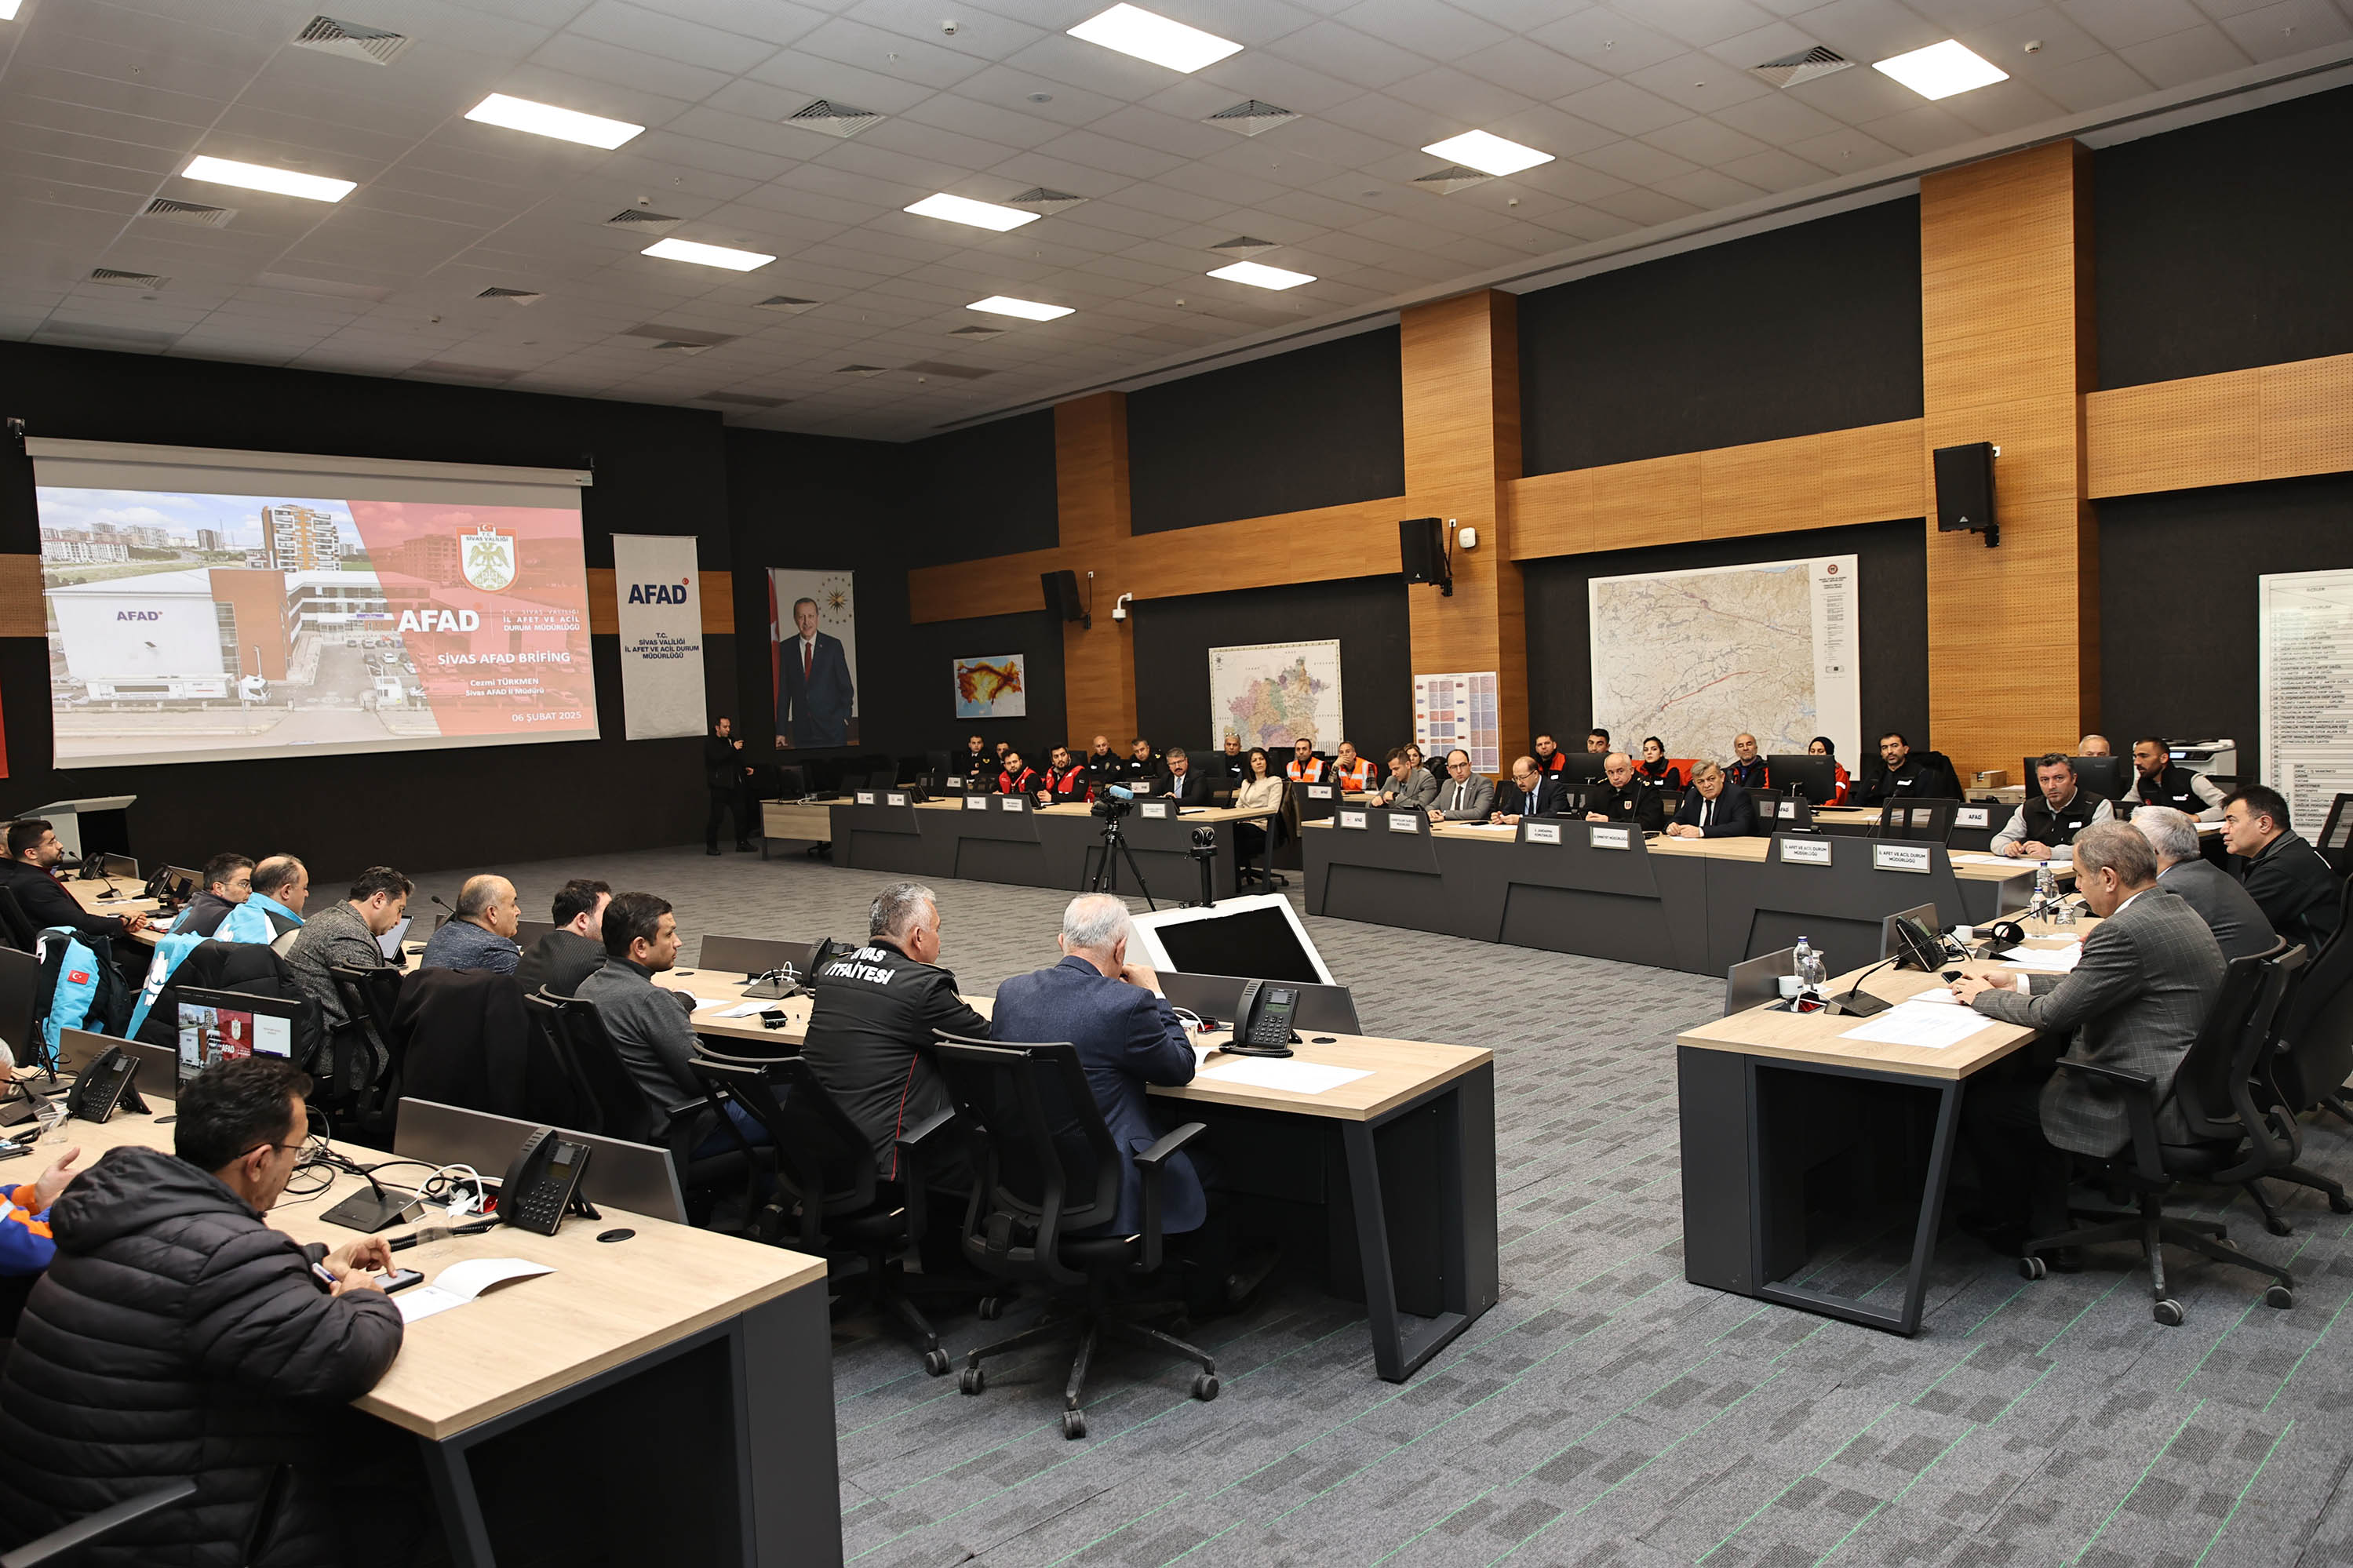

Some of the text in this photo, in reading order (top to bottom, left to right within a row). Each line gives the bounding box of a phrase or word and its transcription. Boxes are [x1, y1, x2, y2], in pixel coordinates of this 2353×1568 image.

[628, 584, 687, 605] AFAD
[117, 611, 158, 621] AFAD
[397, 609, 479, 632] AFAD
[534, 622, 581, 631] MÜDÜRLÜĞÜ
[438, 650, 570, 665] SİVAS AFAD BRİFİNG
[526, 712, 556, 723] ŞUBAT
[559, 711, 582, 720] 2025
[824, 961, 896, 985] İTFAİYESİ
